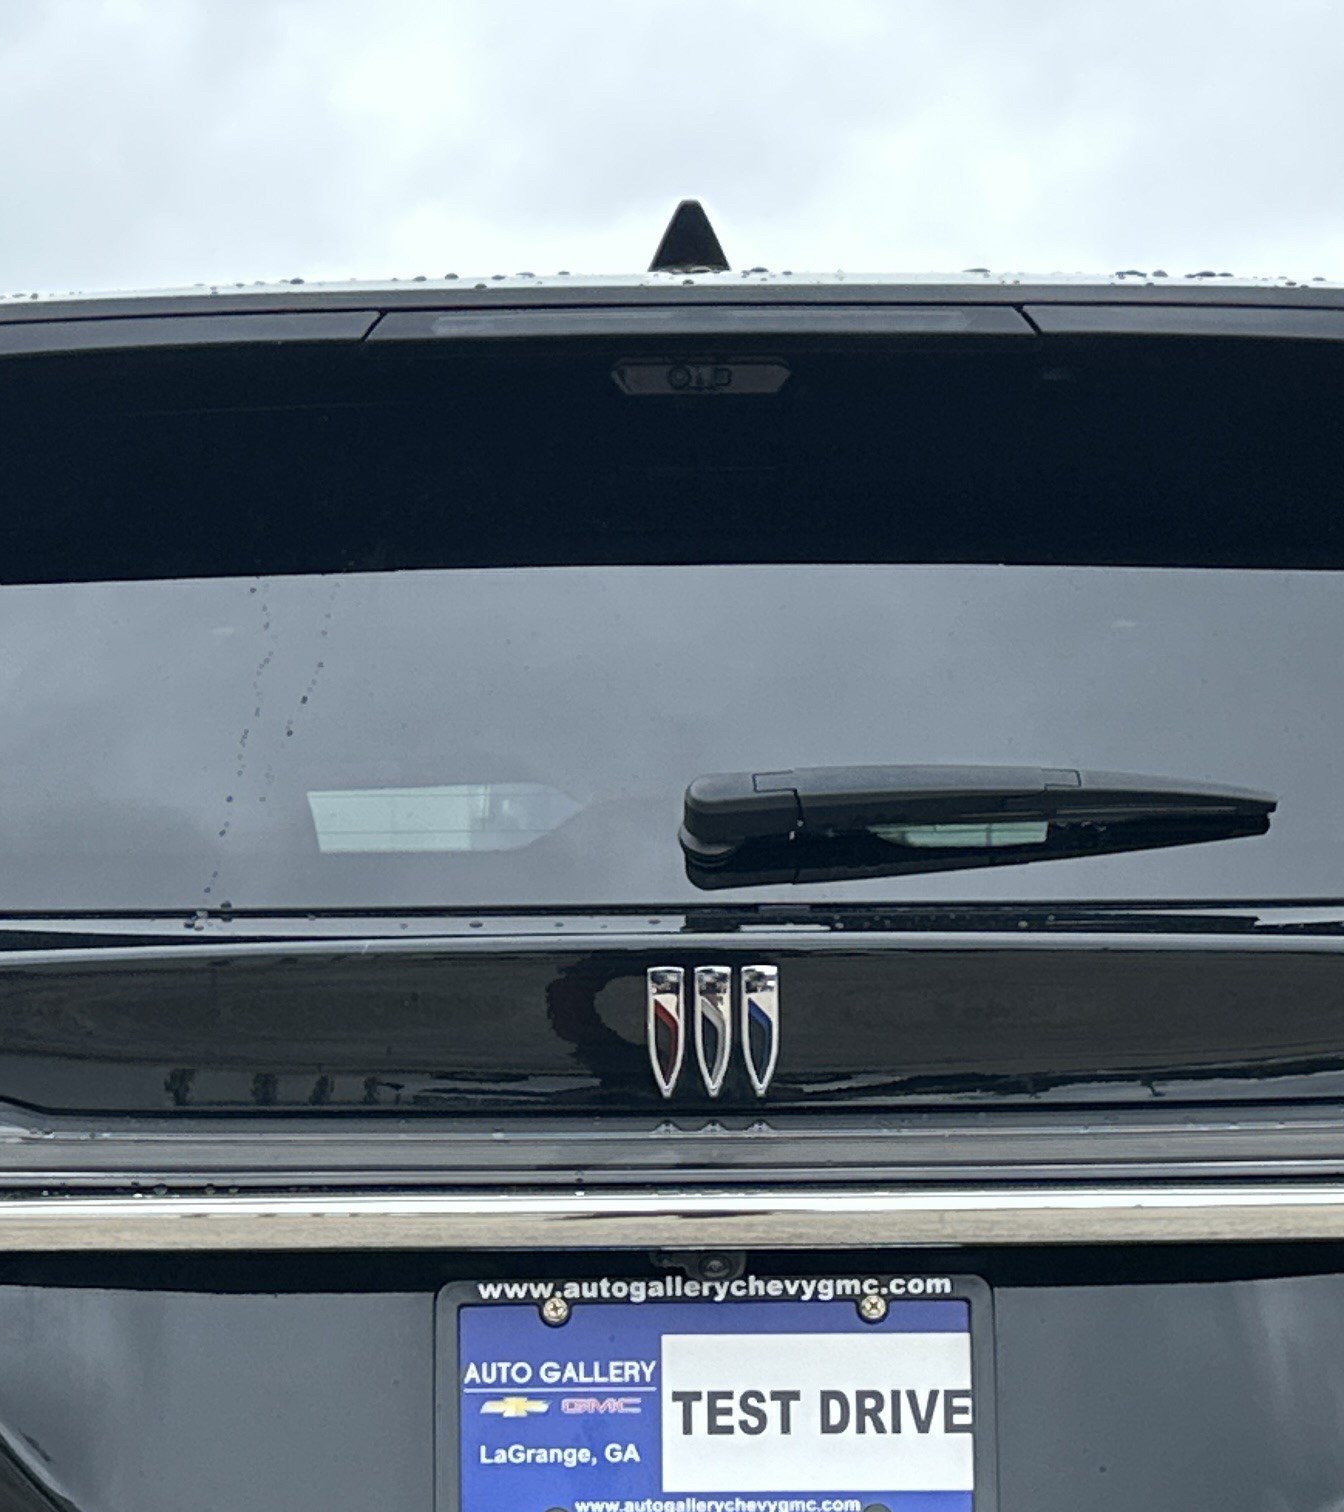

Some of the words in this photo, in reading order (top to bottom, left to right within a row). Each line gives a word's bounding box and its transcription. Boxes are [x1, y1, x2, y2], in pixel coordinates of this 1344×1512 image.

[477, 1275, 953, 1302] www.autogallerychevygmc.com
[463, 1361, 533, 1385] AUTO
[539, 1360, 657, 1384] GALLERY
[560, 1397, 642, 1414] GMC
[671, 1390, 802, 1436] TEST
[820, 1388, 974, 1435] DRIVE
[479, 1444, 598, 1467] LaGrange,
[605, 1444, 641, 1464] GA
